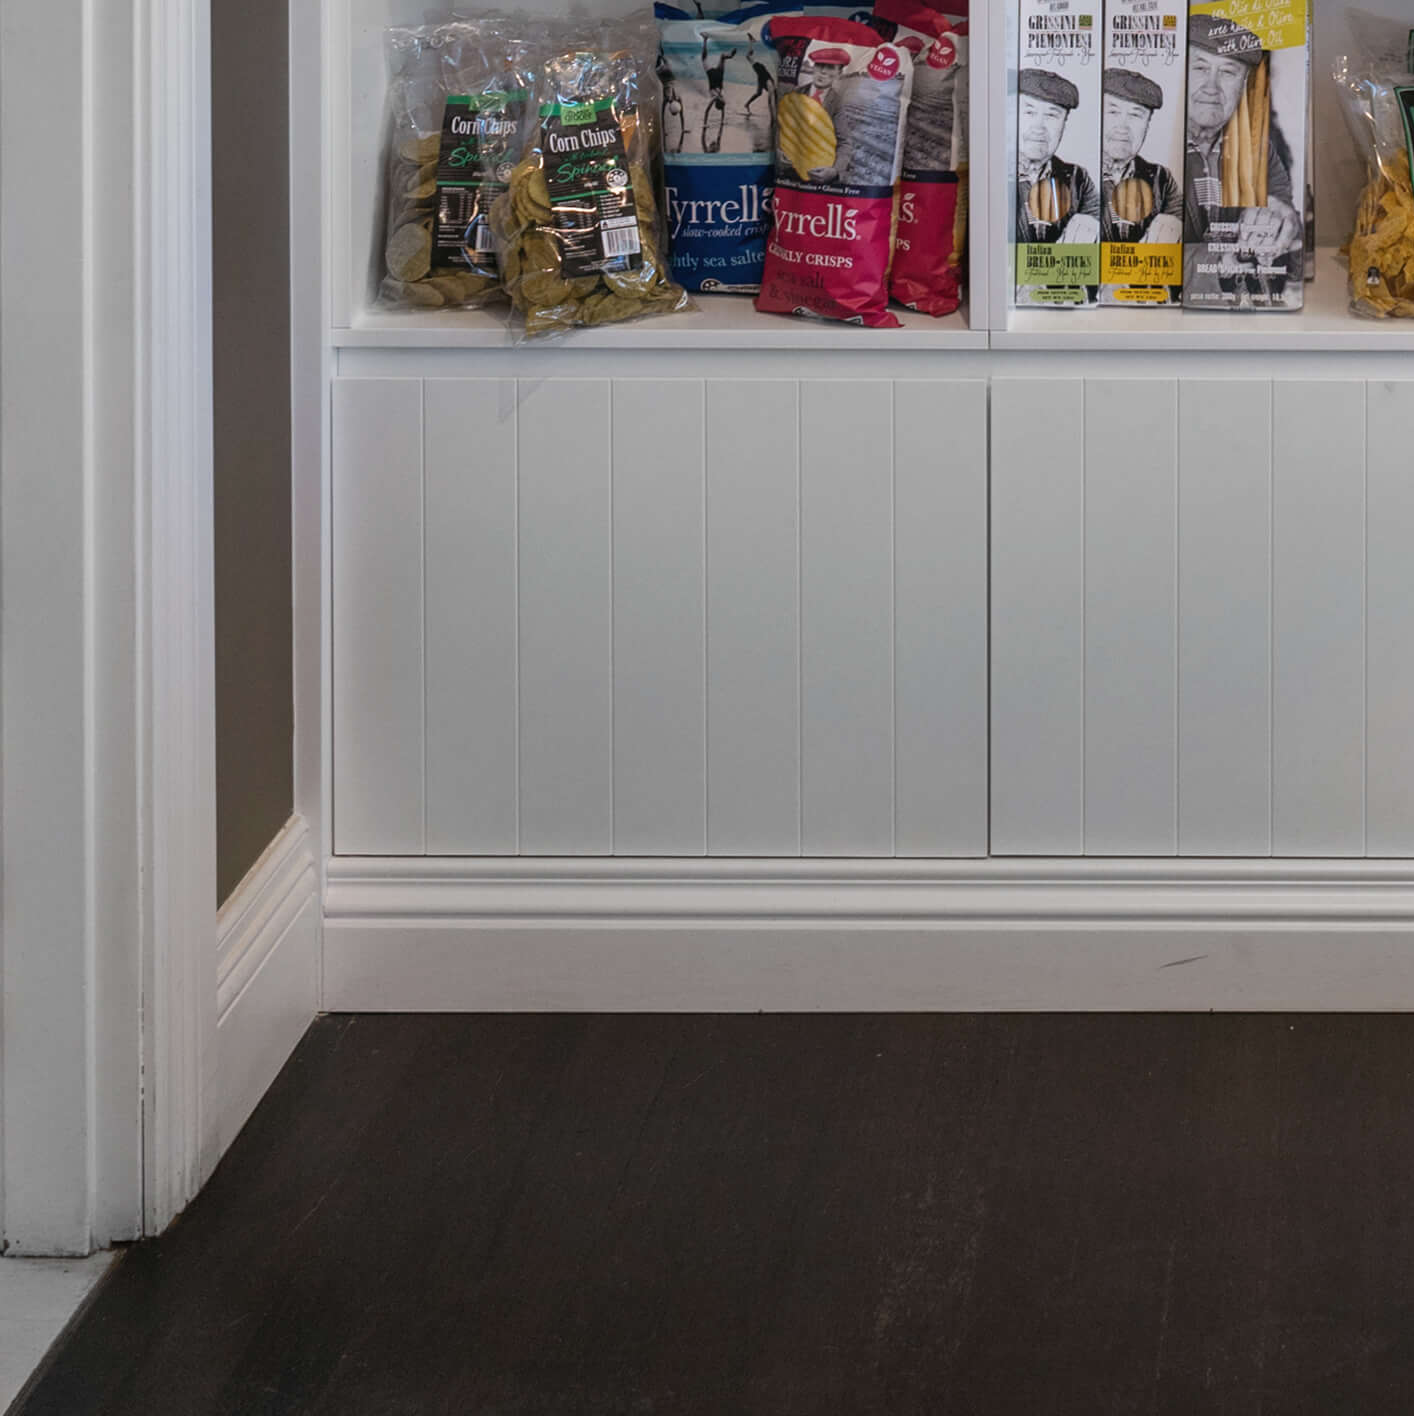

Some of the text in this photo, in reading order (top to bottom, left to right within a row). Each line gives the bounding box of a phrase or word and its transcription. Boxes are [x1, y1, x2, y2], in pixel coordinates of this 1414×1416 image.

[1028, 15, 1076, 30] GRISSINI
[1112, 15, 1160, 30] GRISSINI
[1028, 33, 1092, 48] PIEMONTESI
[1112, 33, 1176, 48] PIEMONTESI
[870, 63, 892, 76] VEGAN
[451, 116, 517, 136] Corn Chips
[550, 128, 616, 153] Corn Chips
[1026, 246, 1052, 254] Italian
[1110, 246, 1135, 254] Italian
[704, 250, 765, 267] sea salte
[806, 252, 853, 268] CRISPS
